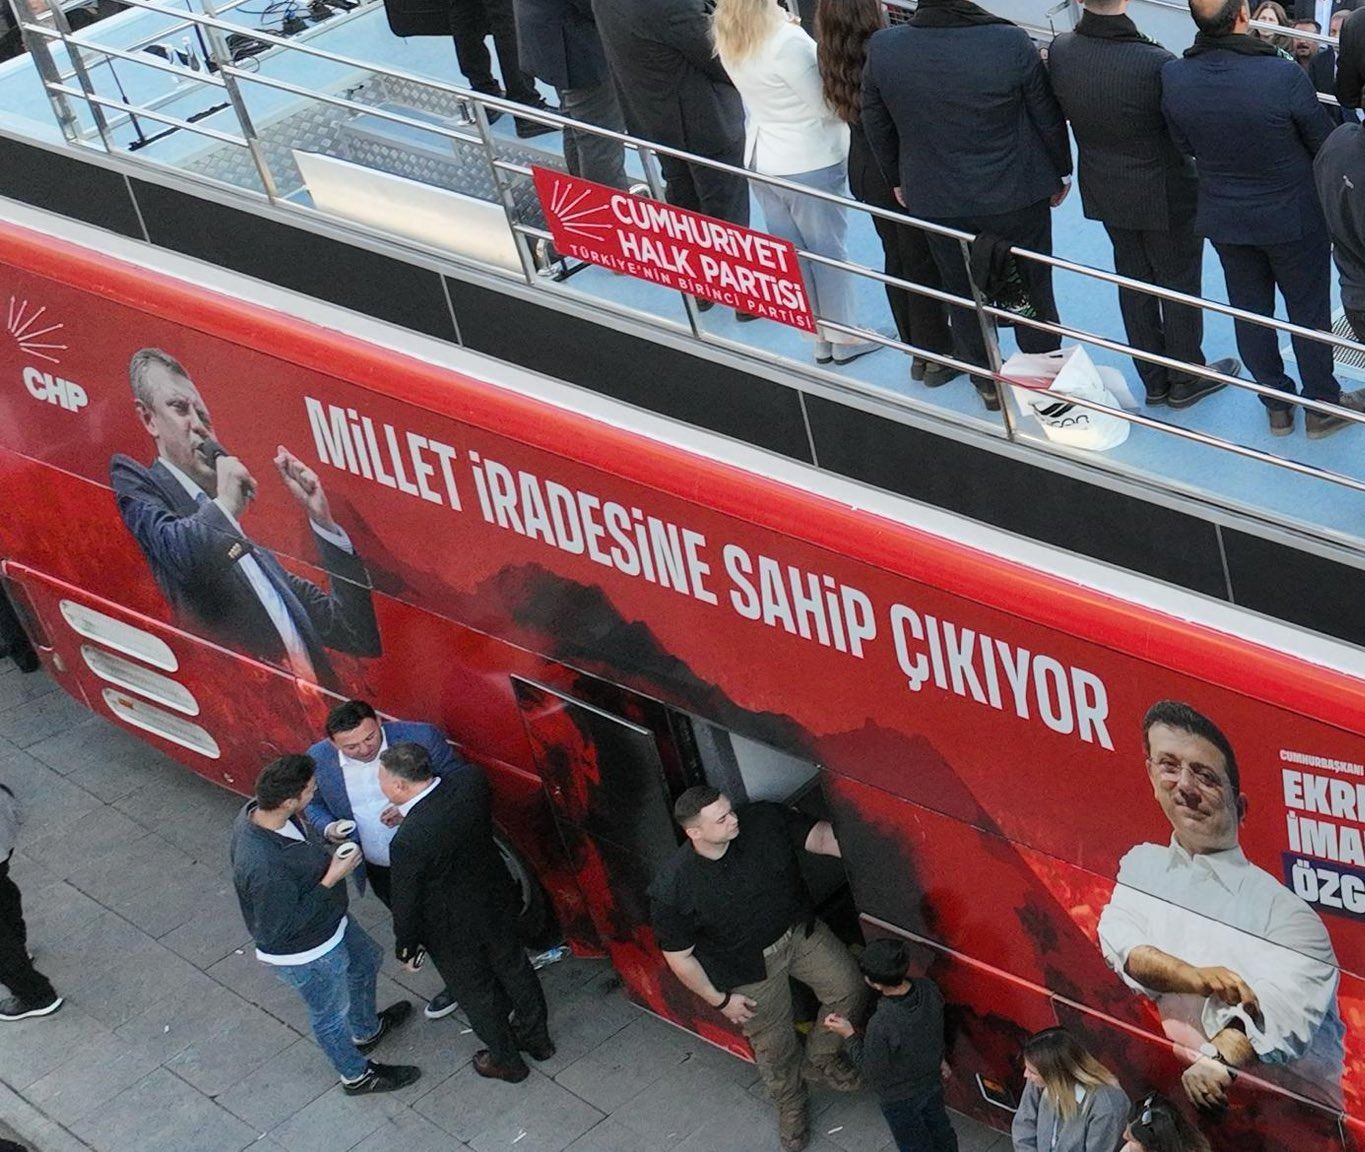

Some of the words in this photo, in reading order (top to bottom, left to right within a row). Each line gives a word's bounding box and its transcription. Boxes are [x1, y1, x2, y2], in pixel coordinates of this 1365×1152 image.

[610, 194, 790, 273] CUMHURİYET
[616, 228, 696, 280] HALK
[699, 253, 807, 314] PARTİSİ
[569, 243, 672, 286] TÜRKİYE'NİN
[678, 277, 742, 307] BİRİNCİ
[747, 299, 813, 331] PARTİSİ
[22, 366, 89, 413] CHP
[303, 394, 464, 512] MİLLET
[469, 448, 718, 608] İRADESİNE
[725, 543, 877, 662] SAHİP
[888, 603, 1117, 752] ÇIKIYOR
[1279, 749, 1365, 777] CUMHURBAŞKANI
